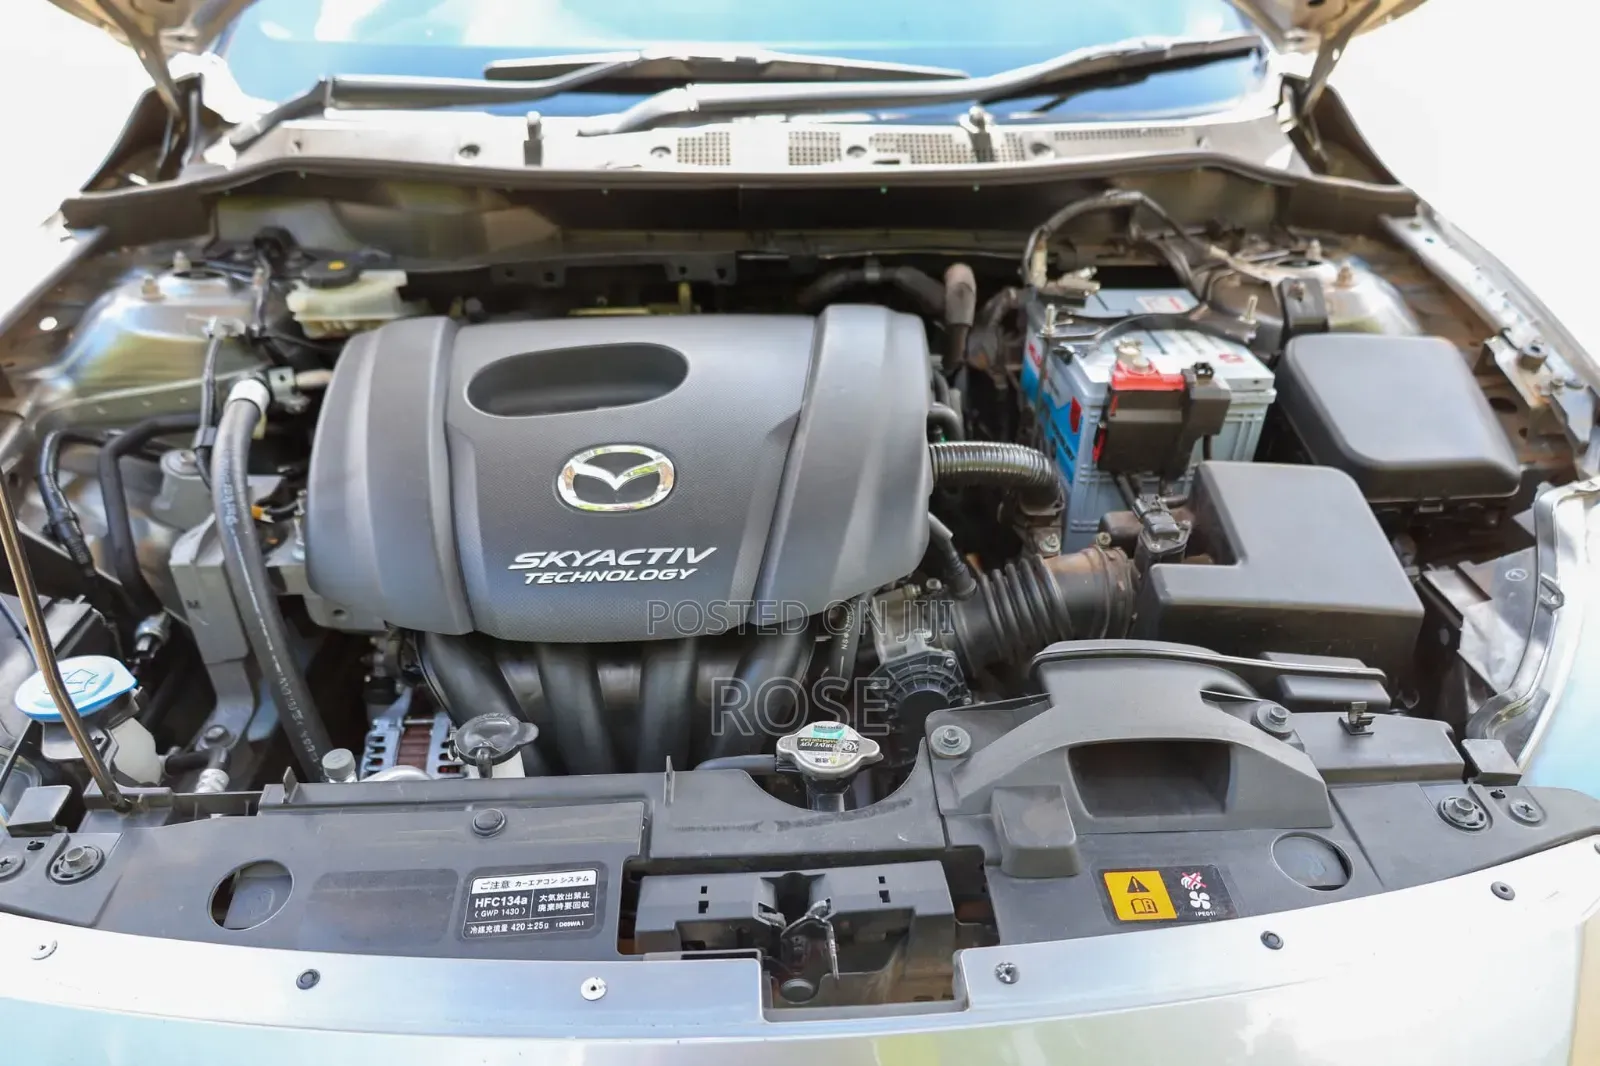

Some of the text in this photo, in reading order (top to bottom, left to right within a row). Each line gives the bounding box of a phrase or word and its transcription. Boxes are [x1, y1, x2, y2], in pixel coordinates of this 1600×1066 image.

[508, 547, 718, 570] SKYACTIV
[524, 568, 698, 585] TECHNOLOGY
[480, 879, 511, 890] ご注意
[475, 895, 528, 908] HFC134a
[539, 891, 591, 903] 大気放出禁止
